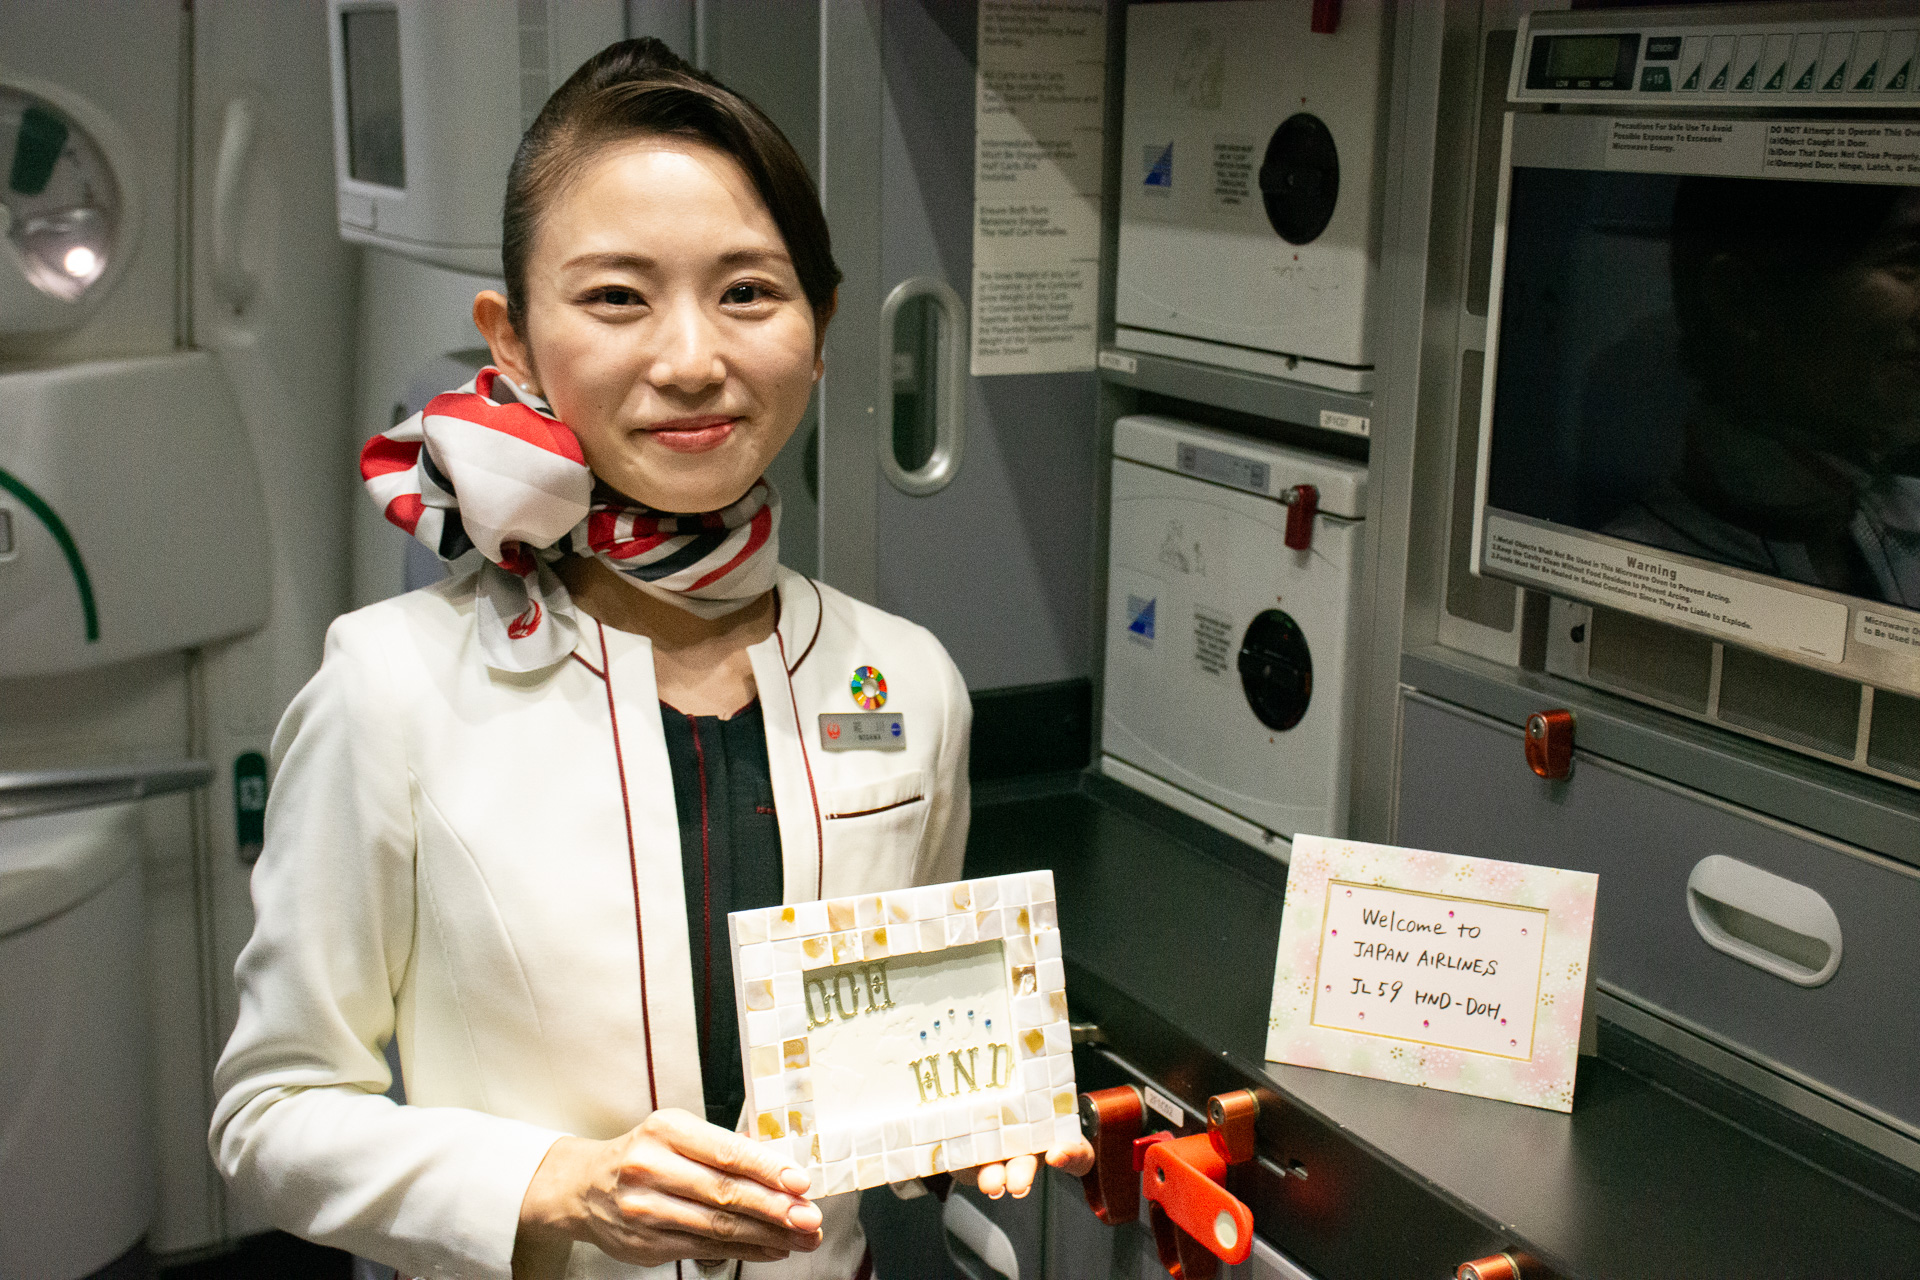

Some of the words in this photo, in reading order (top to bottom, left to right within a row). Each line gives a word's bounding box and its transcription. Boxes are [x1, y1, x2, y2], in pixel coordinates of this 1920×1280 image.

[1646, 75, 1664, 84] +10
[1692, 76, 1697, 87] 1
[1716, 77, 1725, 87] 2
[1744, 76, 1752, 87] 3
[1772, 76, 1780, 87] 4
[1803, 76, 1811, 87] 5
[1833, 76, 1842, 87] 6
[1865, 75, 1873, 87] 7
[1896, 75, 1905, 87] 8
[1615, 122, 1653, 130] Precautions
[1712, 124, 1732, 132] Avoid
[1770, 126, 1781, 134] DO
[1803, 127, 1834, 136] Attempt
[1848, 128, 1881, 136] Operate
[1884, 128, 1901, 136] This
[1614, 132, 1640, 140] Possible
[1643, 133, 1674, 142] Exposure
[1807, 138, 1834, 147] Caught
[1799, 149, 1816, 157] That
[1819, 150, 1837, 158] Does
[1515, 540, 1537, 552] Objects
[1538, 546, 1553, 556] Shall
[1554, 550, 1565, 559] Not
[1566, 554, 1574, 562] Be
[1576, 556, 1592, 566] Used
[1593, 560, 1599, 568] in
[1601, 562, 1614, 572] This
[1616, 566, 1650, 581] Microwave
[1651, 576, 1668, 586] Oven
[1678, 583, 1705, 596] Prevent
[1524, 551, 1542, 563] Cavity
[1543, 557, 1560, 566] Clean
[1562, 561, 1584, 573] Without
[1586, 568, 1601, 578] Food
[1603, 572, 1631, 587] Residues
[1633, 581, 1639, 589] to
[1641, 584, 1666, 596] Prevent
[1626, 556, 1677, 581] Warning
[1514, 559, 1528, 568] Must
[1530, 563, 1540, 571] Not
[1551, 568, 1572, 580] Heated
[1581, 577, 1601, 588] Sealed
[1603, 583, 1637, 598] Containers
[1639, 592, 1657, 604] Since
[1659, 598, 1675, 610] They
[1677, 603, 1688, 613] Are
[1690, 607, 1711, 618] Liable
[1713, 613, 1720, 621] to
[1865, 616, 1909, 633] Microwave
[1864, 627, 1872, 635] to
[1875, 629, 1886, 638] Be
[1888, 632, 1910, 644] Used
[1363, 908, 1447, 936] Welcome
[1457, 923, 1481, 938] to
[1353, 941, 1409, 963] JAPAN
[1350, 978, 1372, 995] JL
[1378, 980, 1403, 1003] 59
[908, 1042, 1015, 1106] HND
